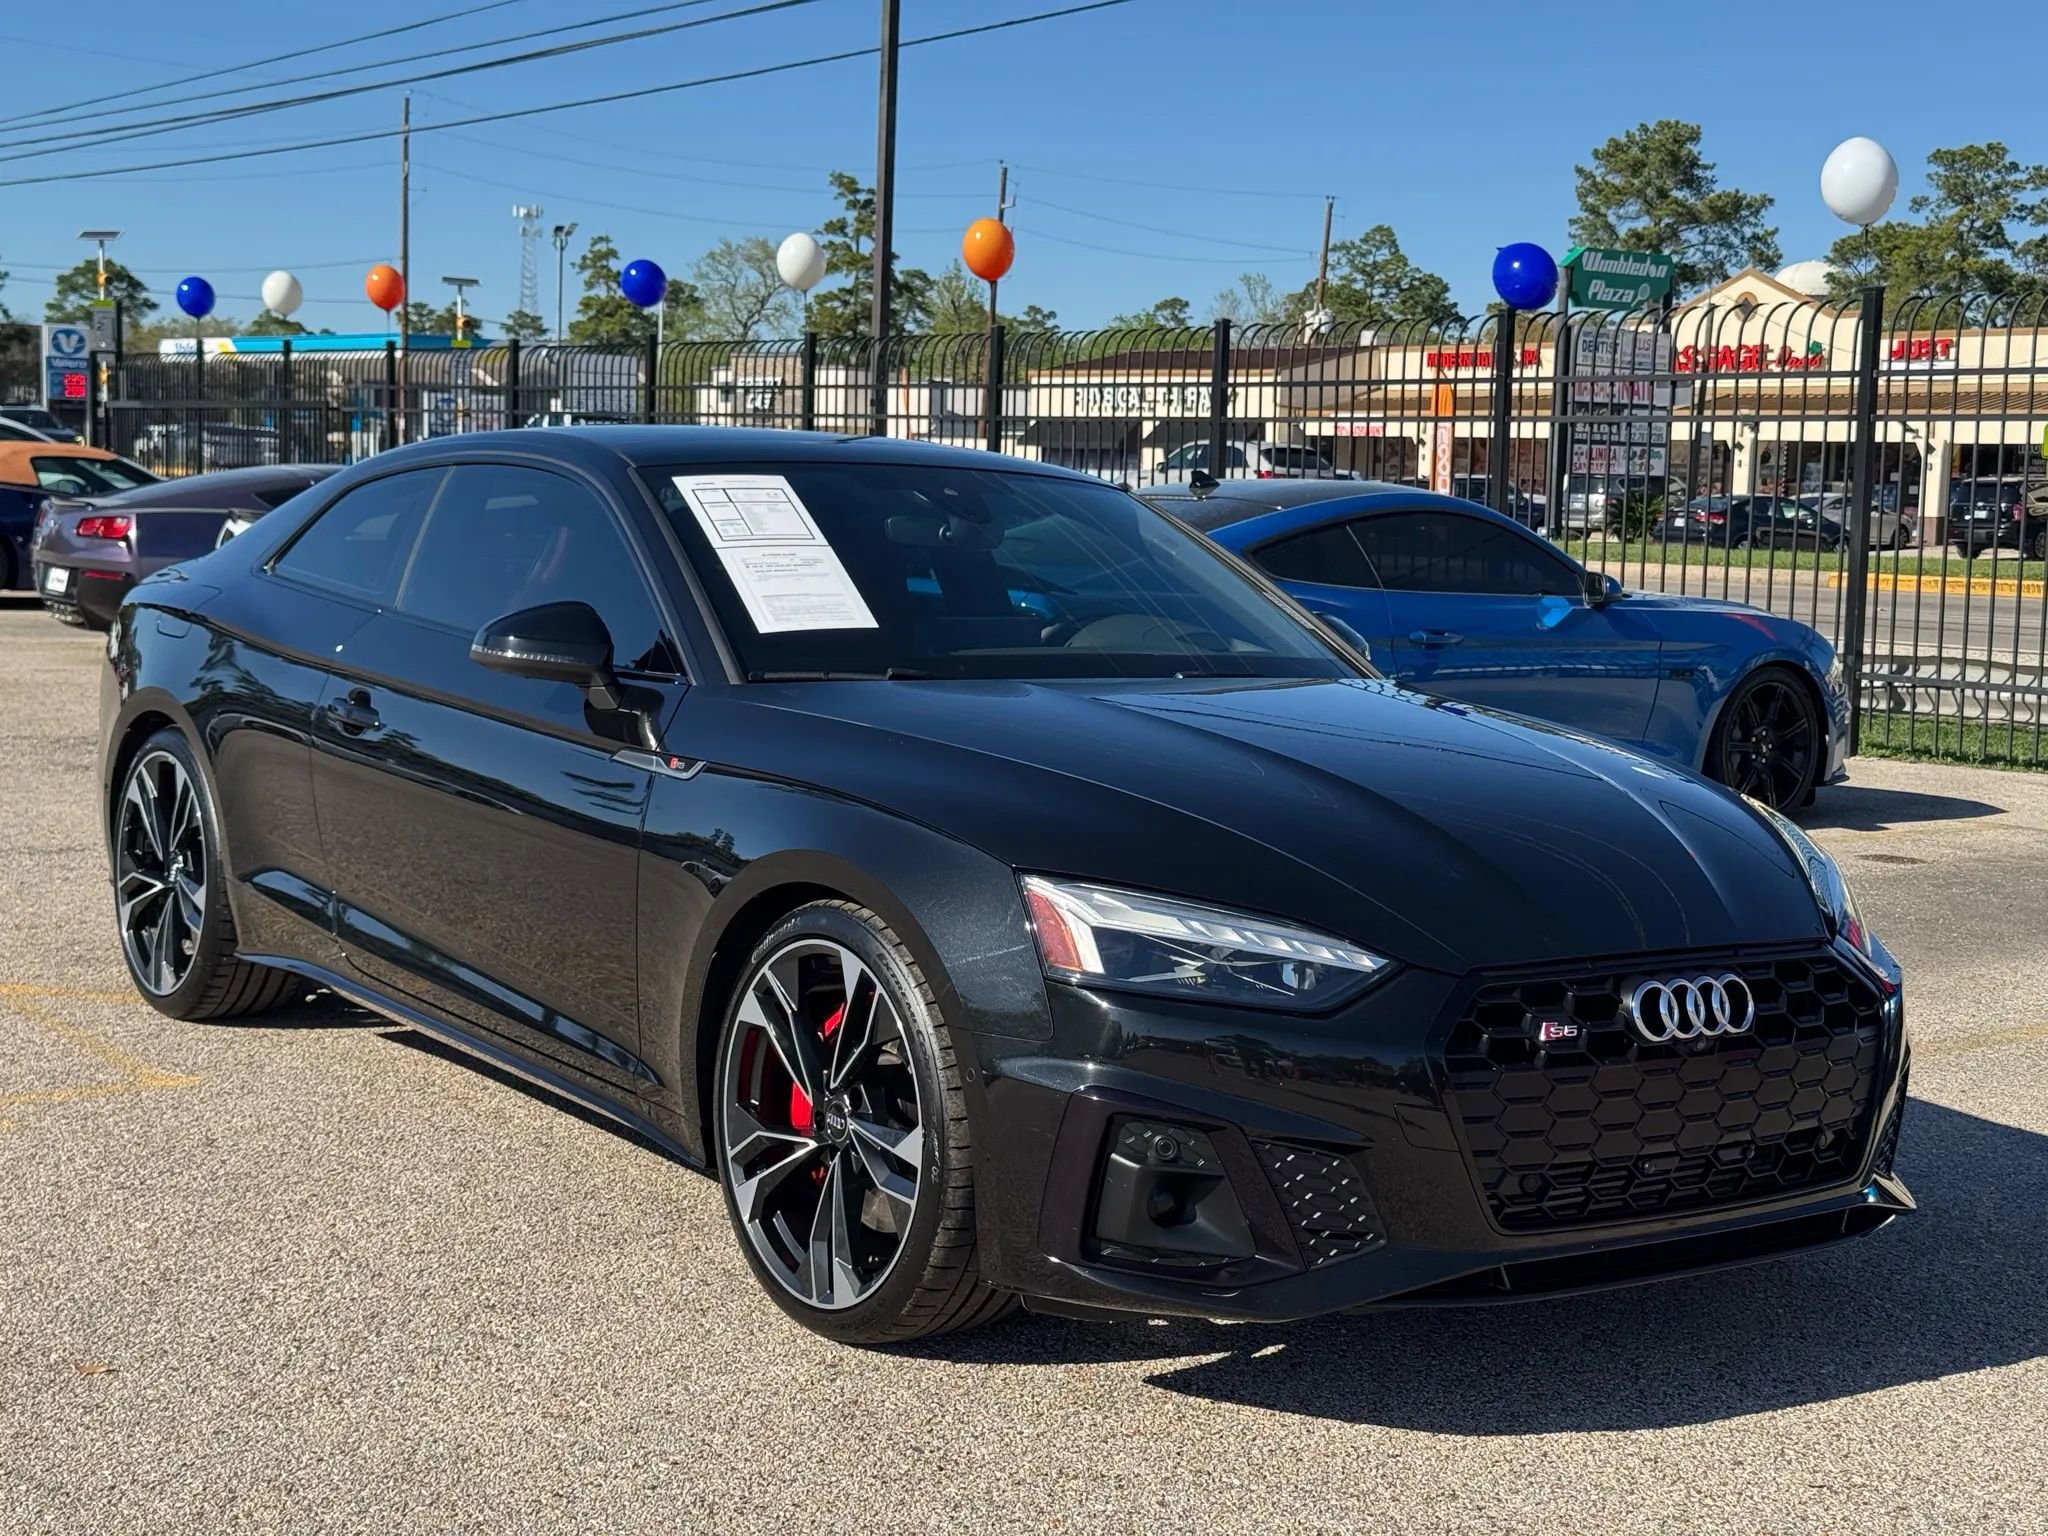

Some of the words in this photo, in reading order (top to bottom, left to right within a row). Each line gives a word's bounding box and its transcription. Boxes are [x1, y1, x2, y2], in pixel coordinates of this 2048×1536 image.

[1581, 251, 1668, 278] Wimbledon
[1588, 279, 1635, 303] Plaza
[1427, 351, 1472, 368] MDERN
[1892, 338, 1953, 360] JUST
[50, 358, 88, 369] Valero
